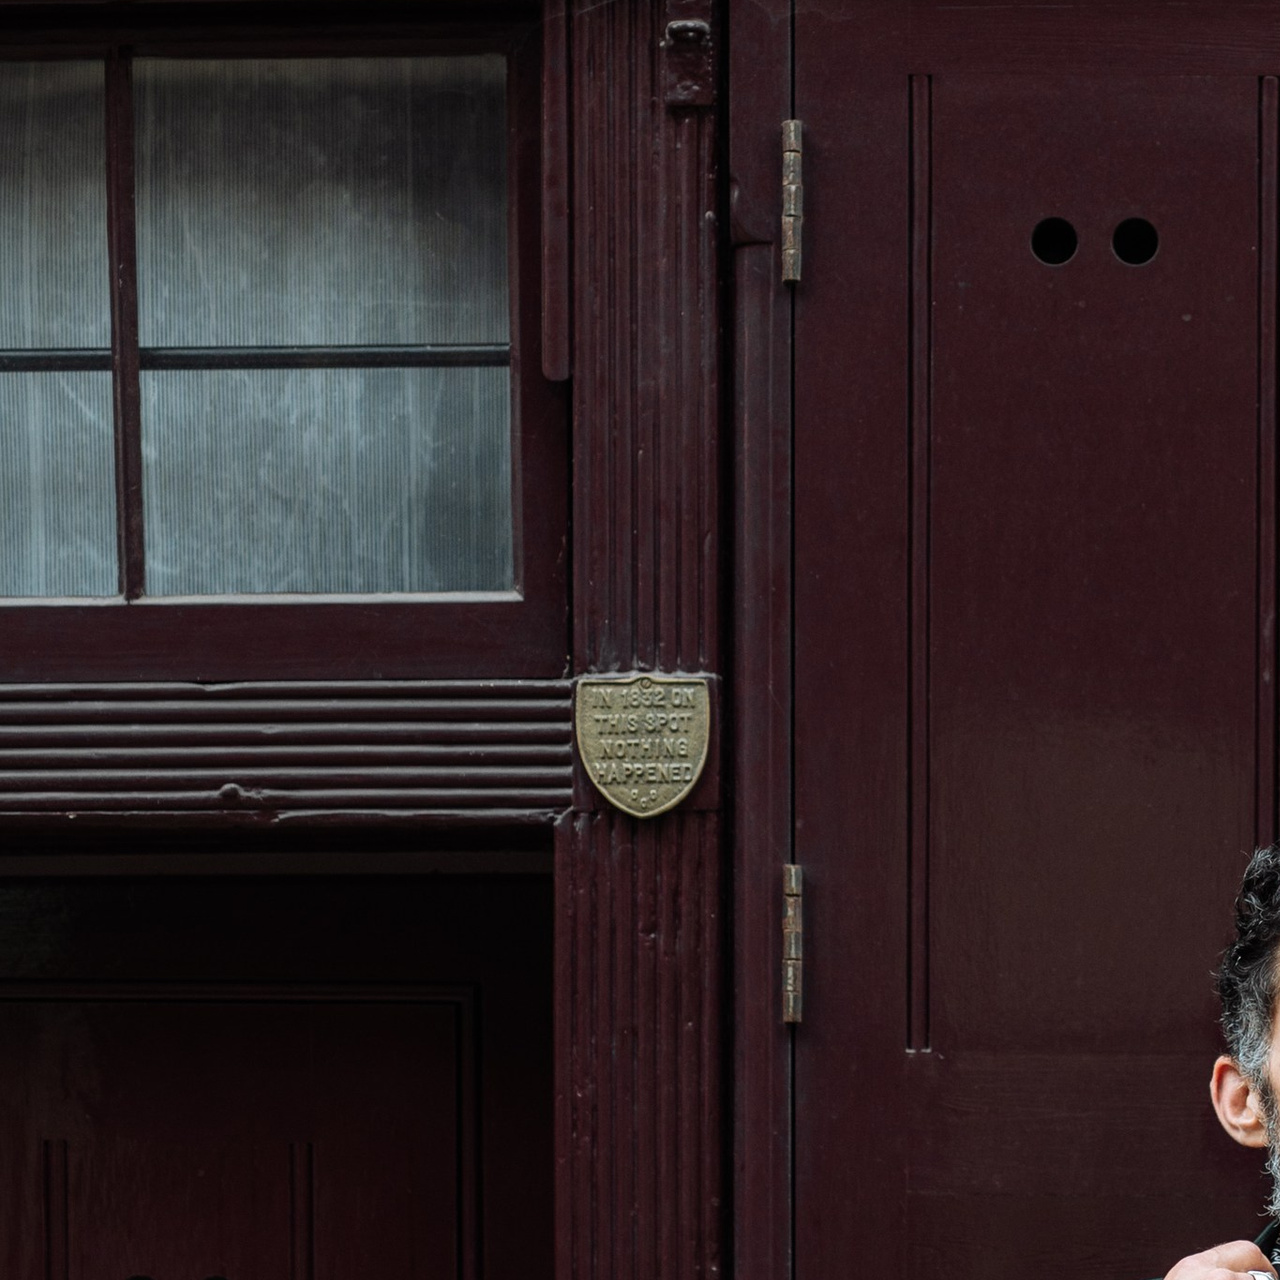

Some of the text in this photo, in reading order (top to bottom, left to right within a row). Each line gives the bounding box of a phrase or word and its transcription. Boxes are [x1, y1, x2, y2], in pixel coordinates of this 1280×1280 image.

[592, 688, 613, 708] IN
[672, 687, 695, 708] ON
[594, 713, 692, 734] THIS SPOT
[599, 738, 688, 759] NOTHING
[592, 763, 693, 785] HAPPENED
